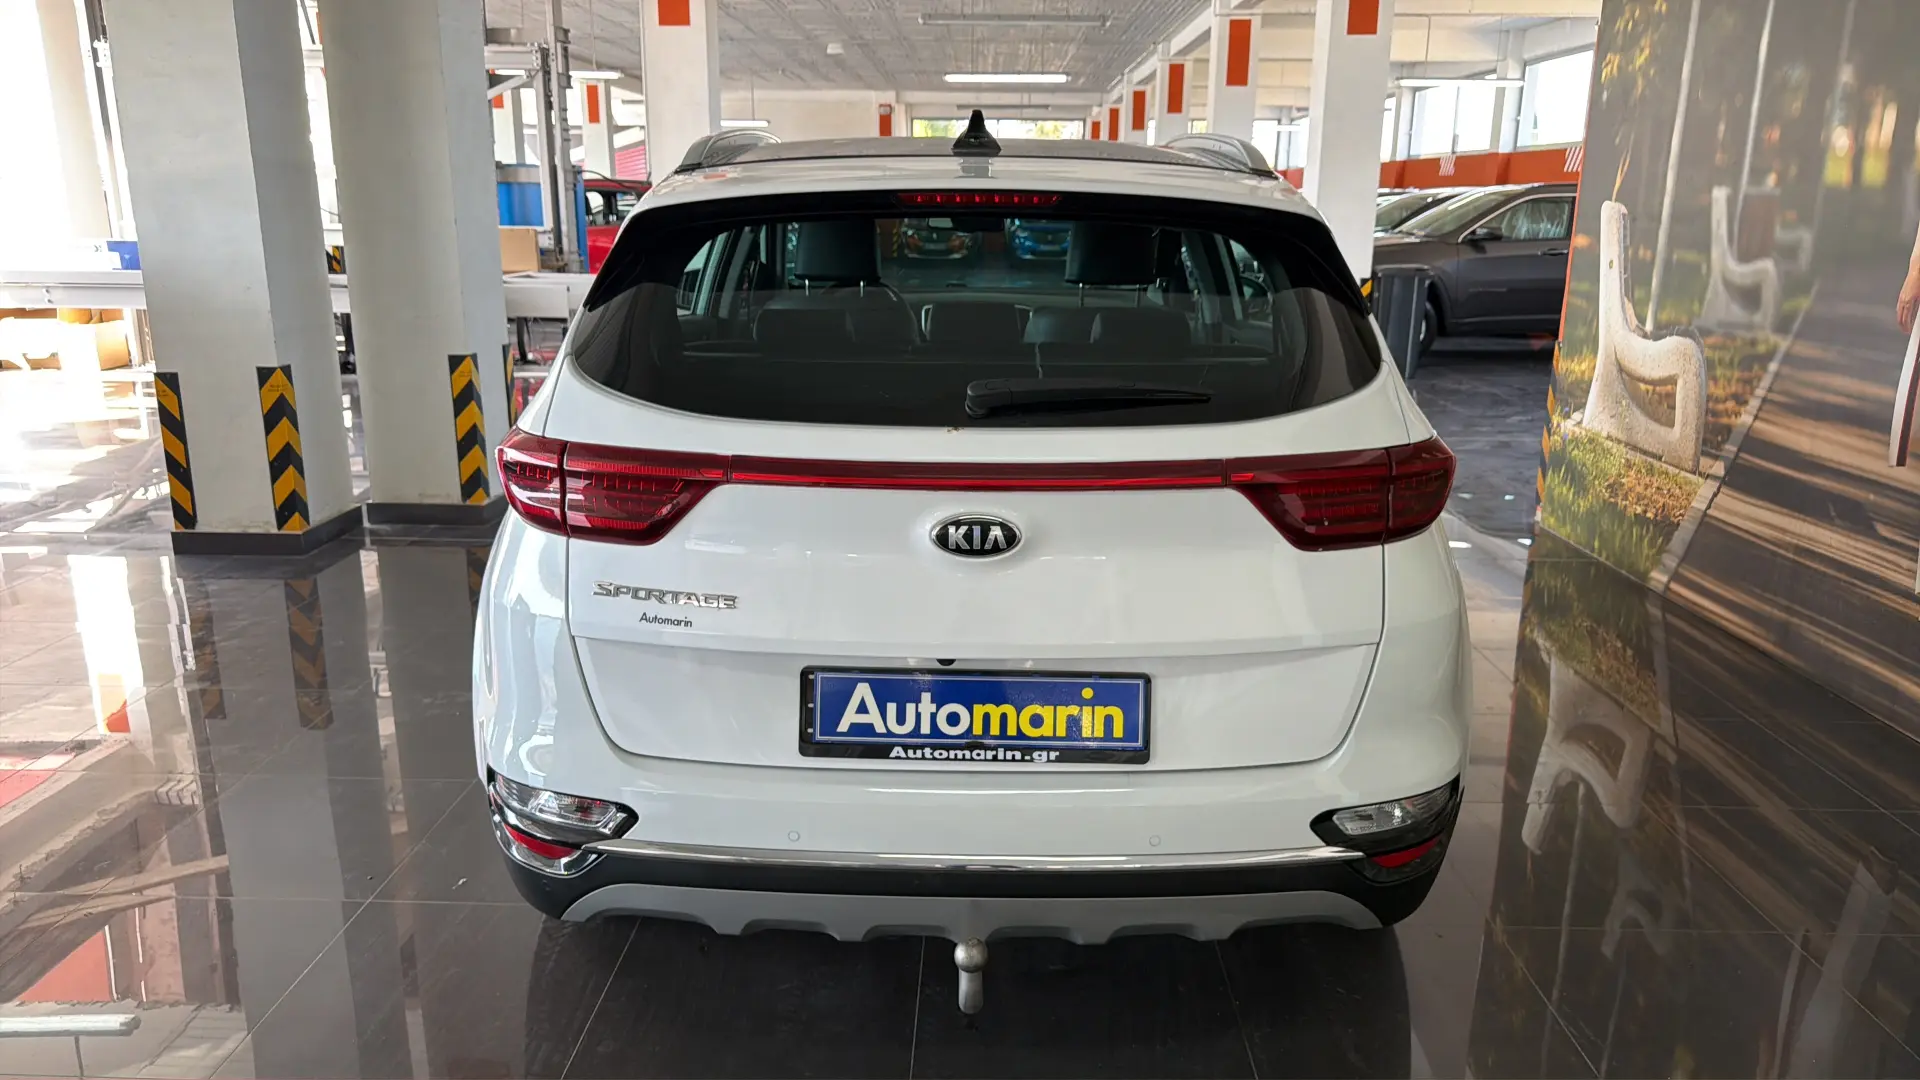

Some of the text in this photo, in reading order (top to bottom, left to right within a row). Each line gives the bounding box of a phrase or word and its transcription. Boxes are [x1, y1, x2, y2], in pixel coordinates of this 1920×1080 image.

[948, 525, 1007, 549] KIA
[591, 580, 739, 609] SPORTAGE
[639, 612, 692, 628] Automarin
[836, 682, 1124, 738] Automarin
[889, 746, 1059, 763] Automarin.gr
